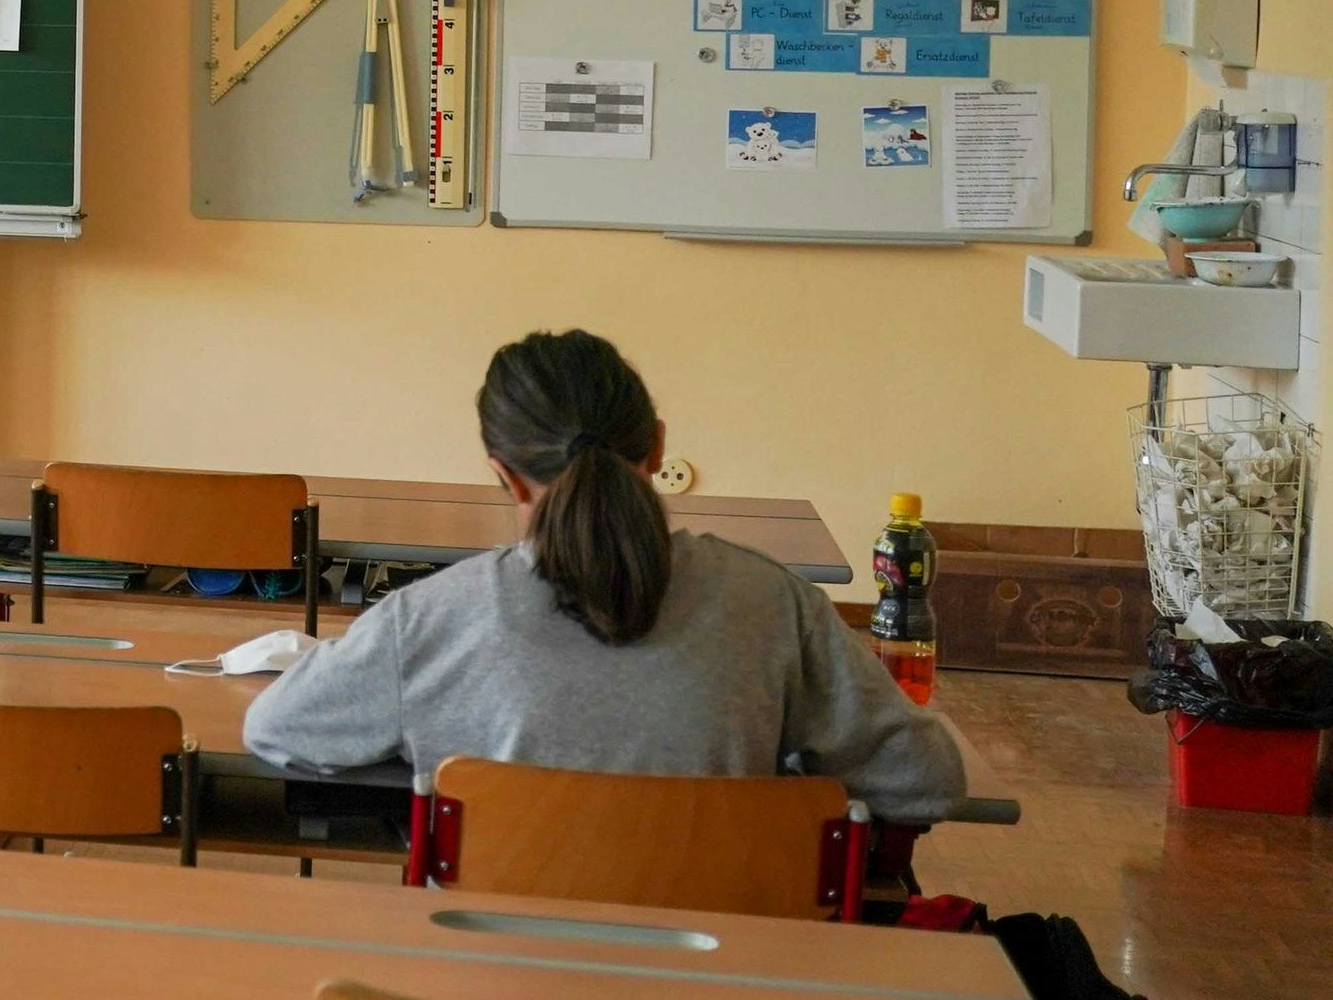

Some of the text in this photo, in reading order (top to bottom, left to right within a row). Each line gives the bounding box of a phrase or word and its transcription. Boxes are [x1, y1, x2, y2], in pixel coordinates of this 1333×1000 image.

[751, 7, 765, 19] PC
[780, 7, 812, 19] Dienst
[886, 10, 944, 22] Regaldienst
[1019, 11, 1076, 24] Tafeldienst
[445, 21, 455, 29] 4
[776, 40, 844, 51] Waschbecken
[776, 55, 806, 66] dienst
[916, 49, 979, 62] Ersatzdienst
[444, 67, 454, 75] 3
[443, 113, 453, 121] 2
